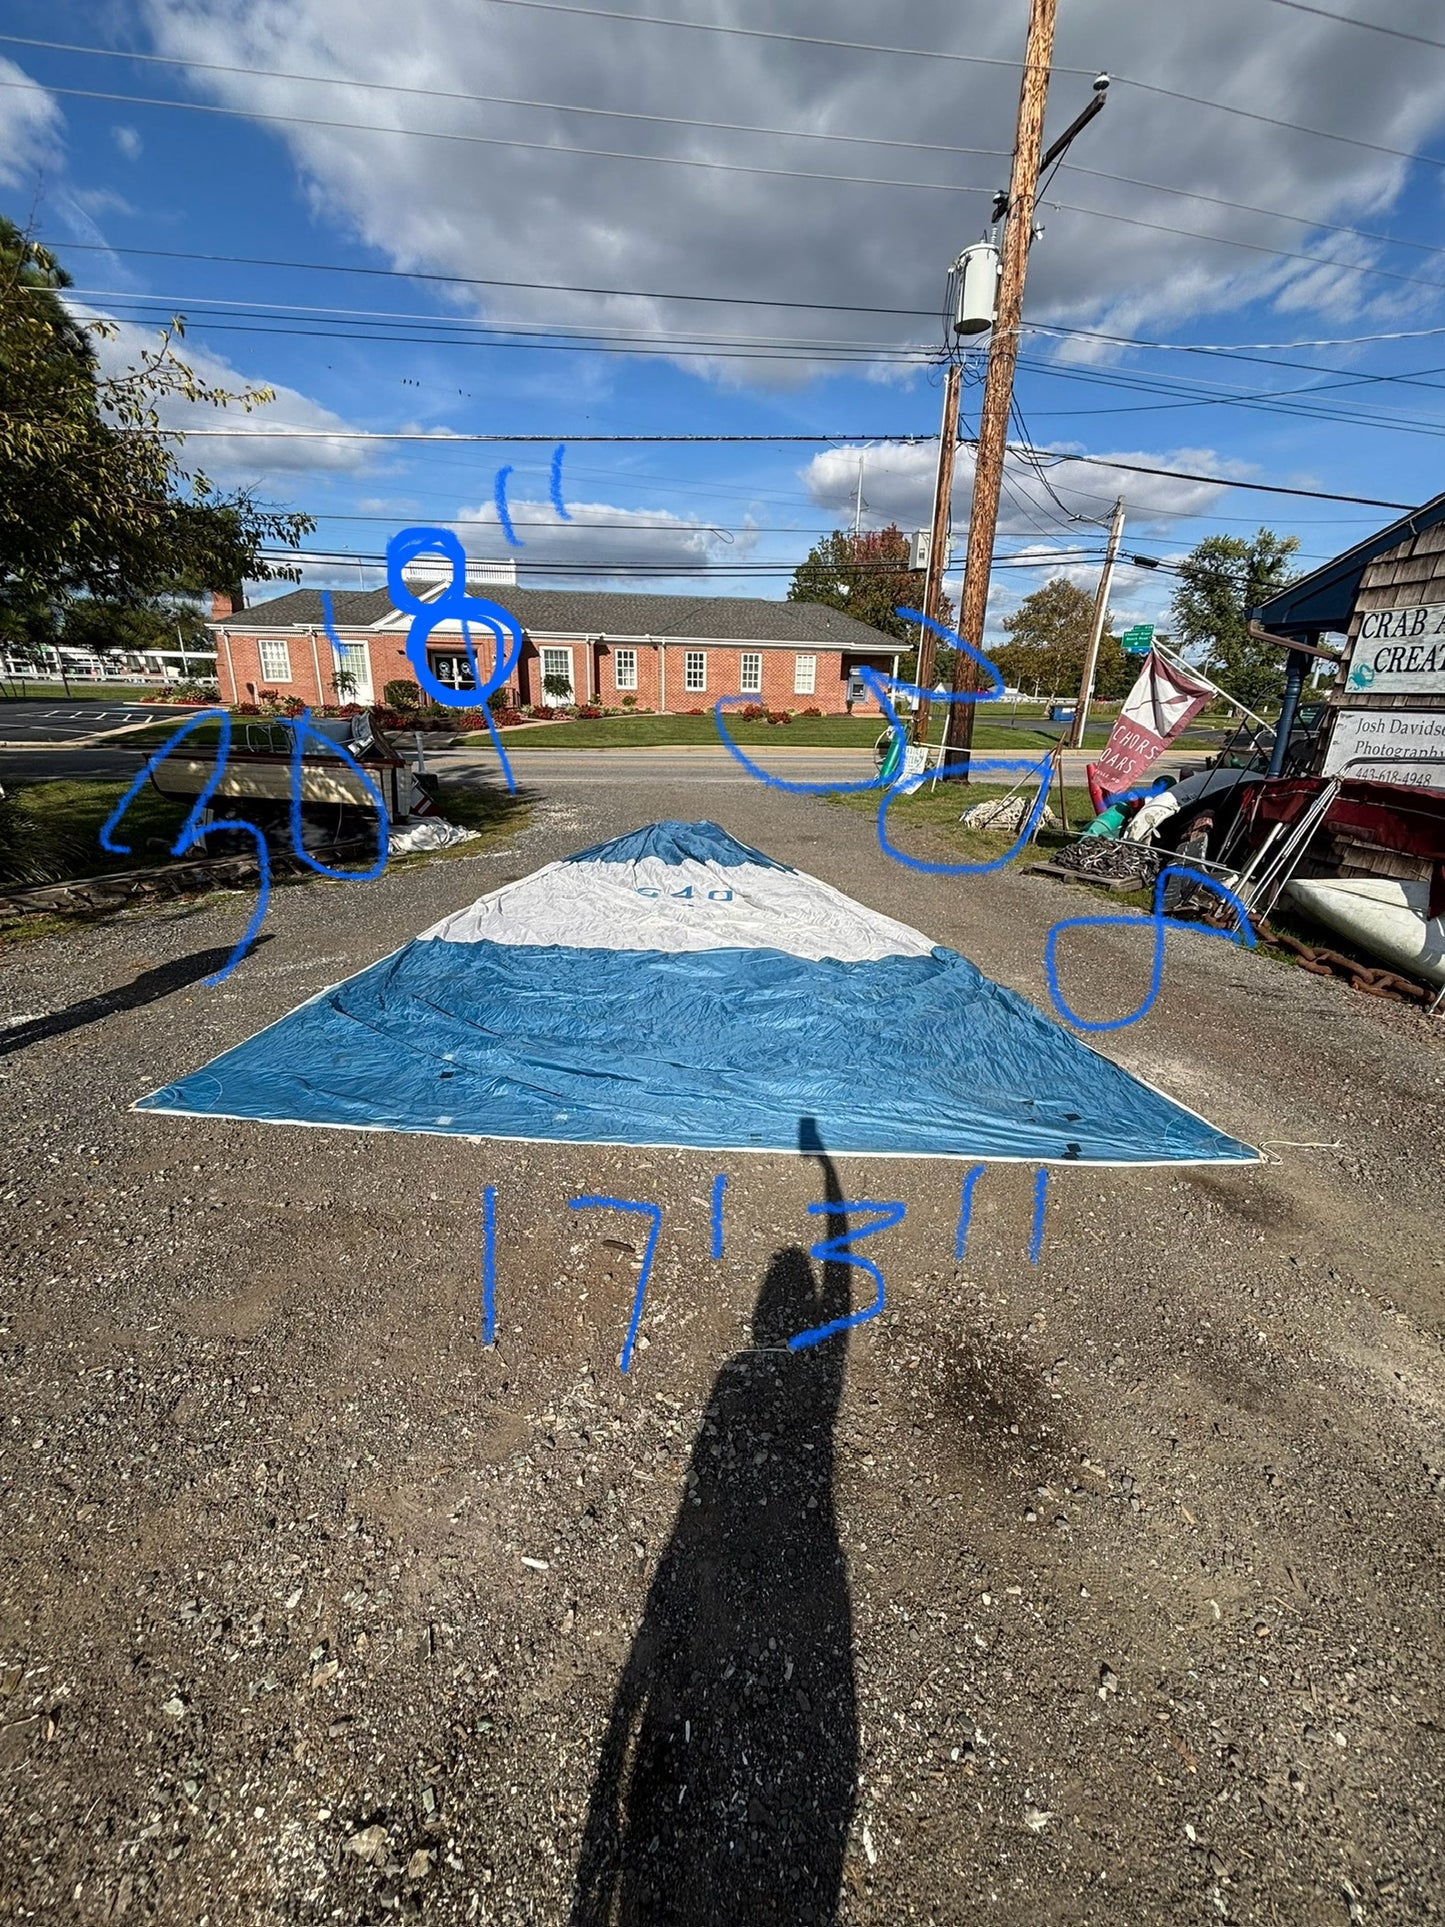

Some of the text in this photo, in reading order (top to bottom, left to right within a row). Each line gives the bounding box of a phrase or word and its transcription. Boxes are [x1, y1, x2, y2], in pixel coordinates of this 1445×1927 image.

[1362, 608, 1428, 639] CRAB
[1355, 718, 1385, 735] Josh
[1113, 722, 1159, 760] CHORS
[1354, 740, 1445, 758] Photograph
[1355, 767, 1432, 788] 443-618-4948
